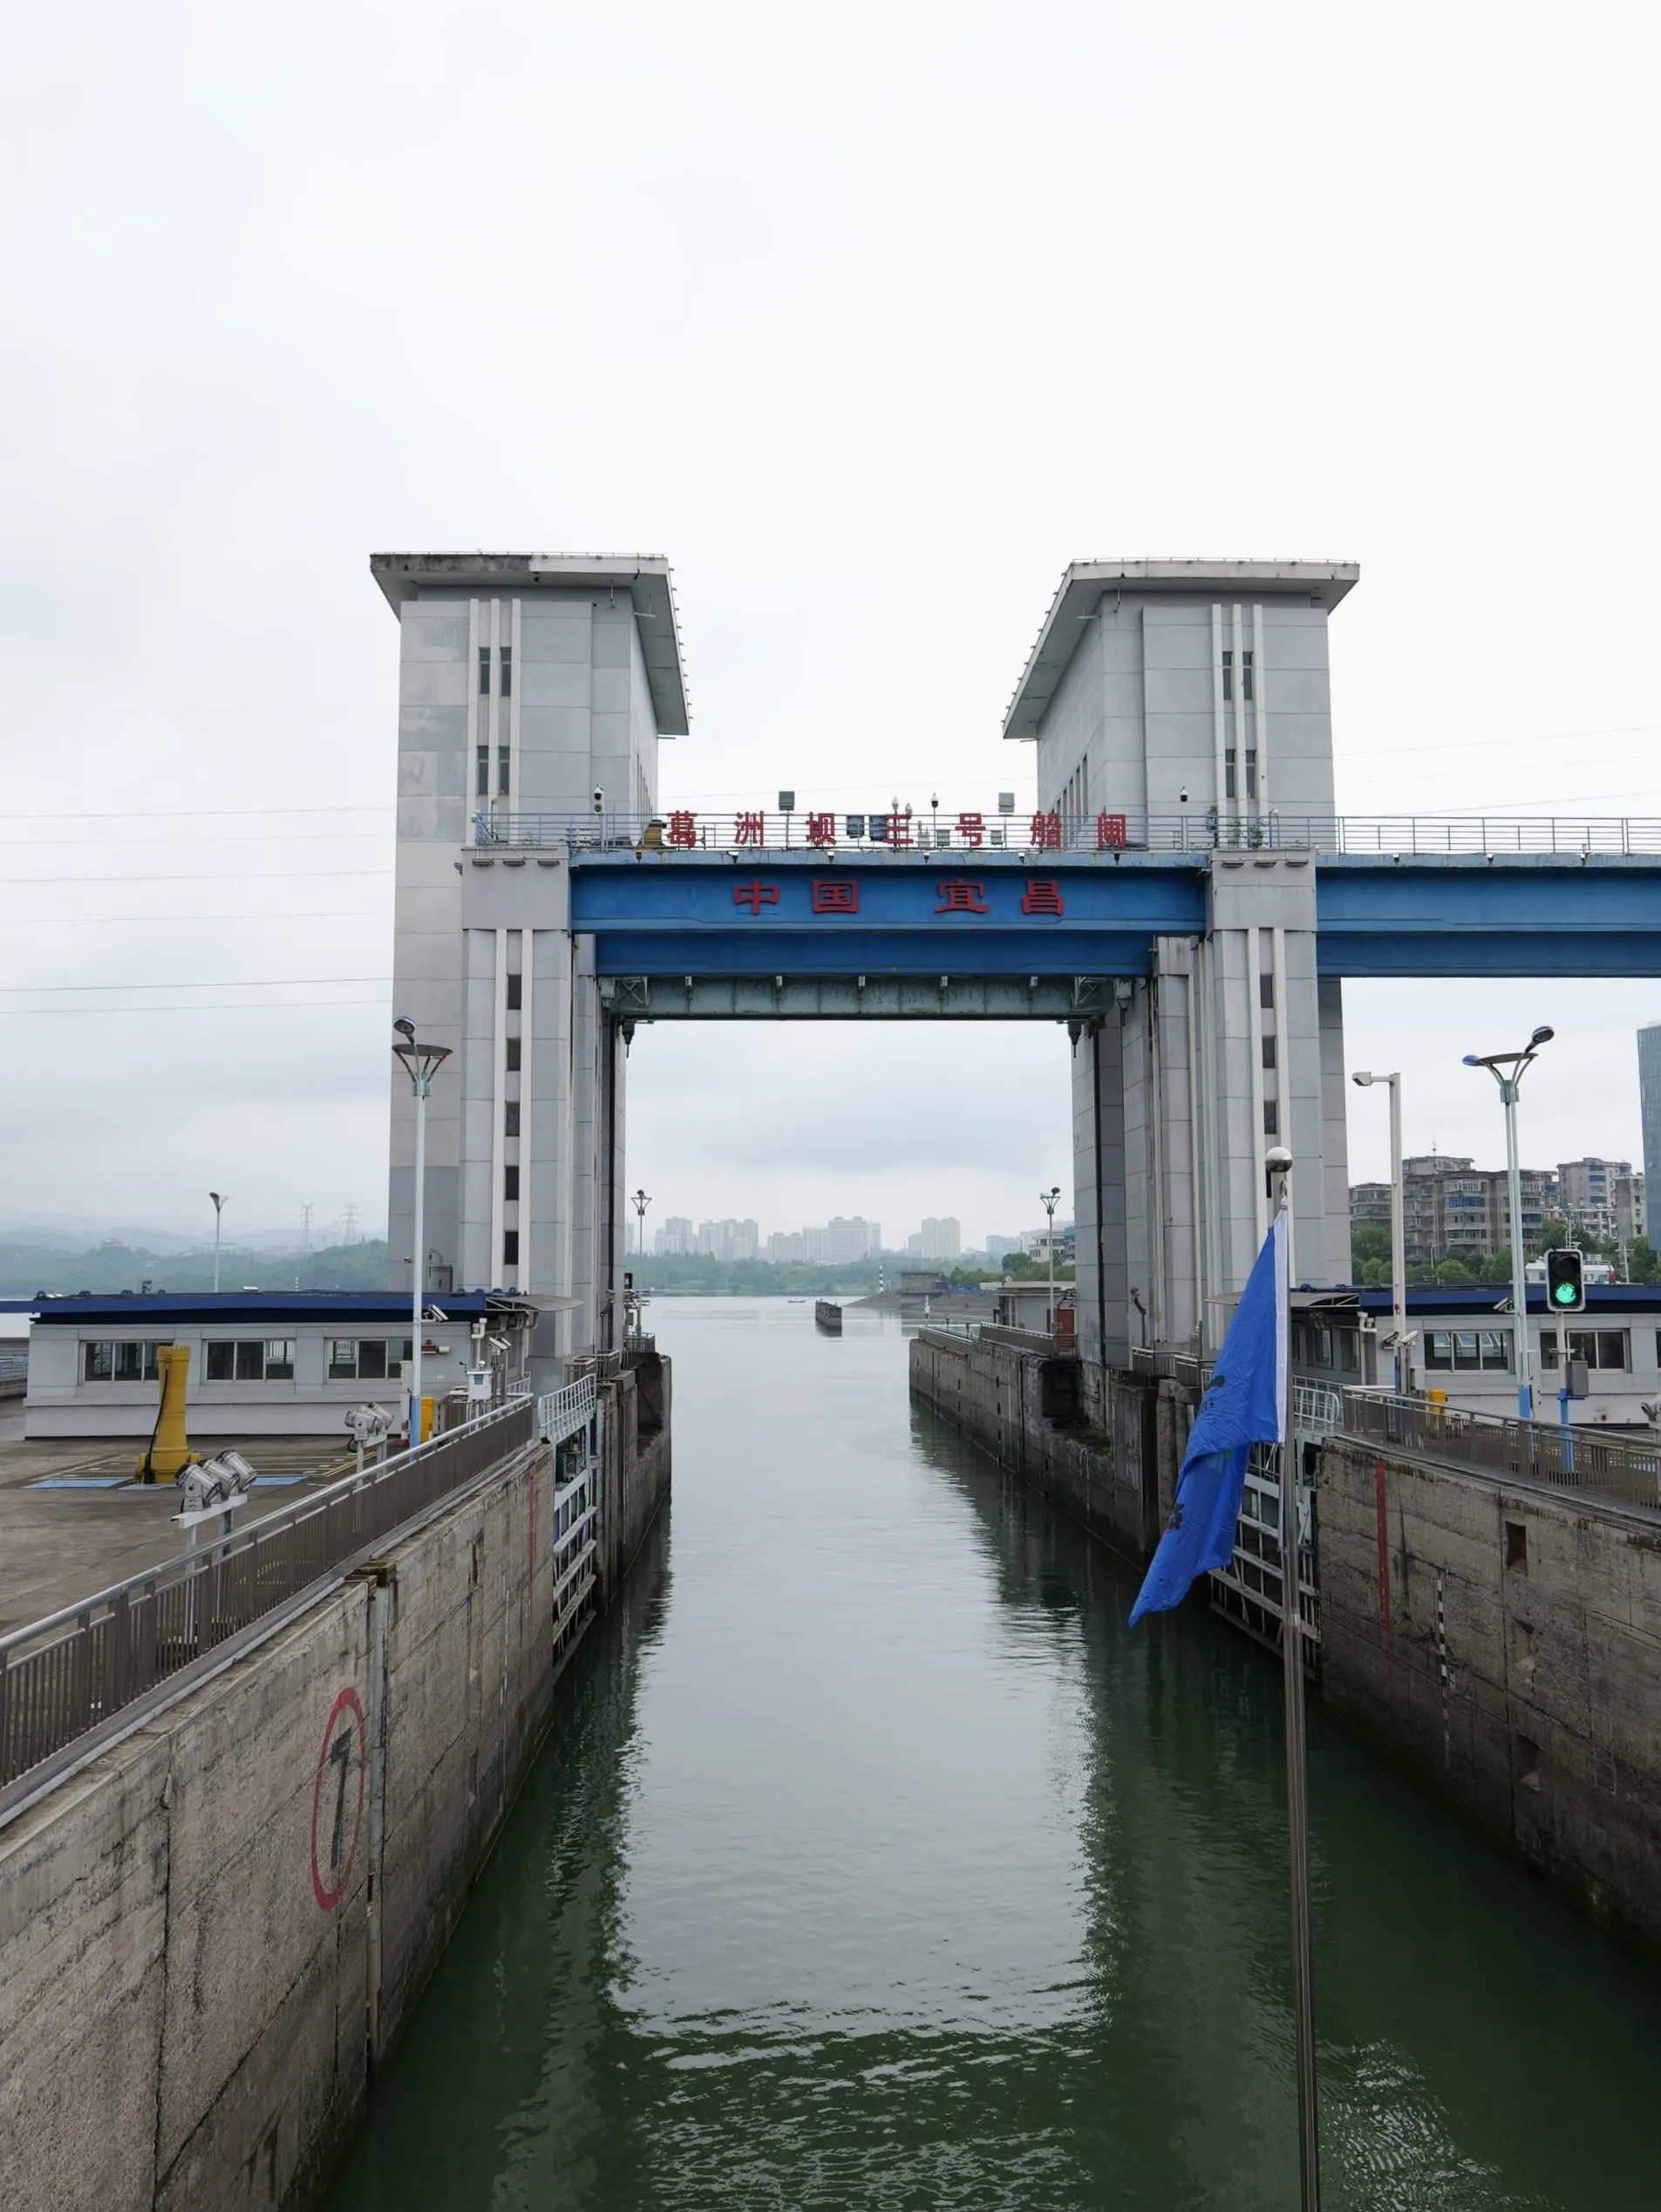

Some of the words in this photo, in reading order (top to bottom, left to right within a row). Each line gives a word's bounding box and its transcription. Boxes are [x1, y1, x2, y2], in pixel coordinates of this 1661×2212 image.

[667, 809, 1127, 848] 葛洲坝三号船闸
